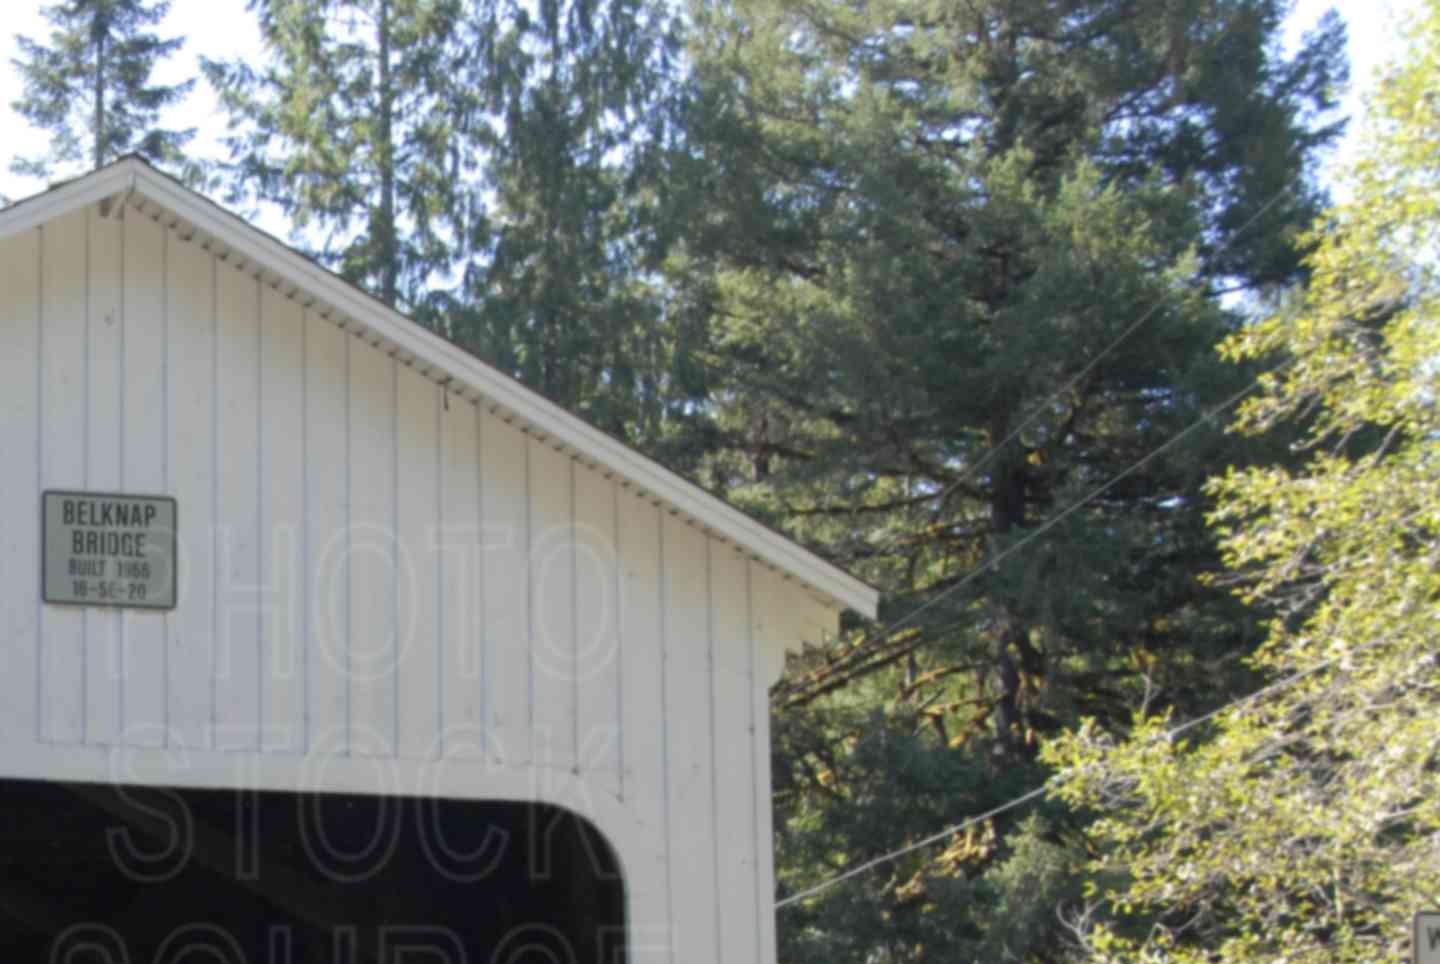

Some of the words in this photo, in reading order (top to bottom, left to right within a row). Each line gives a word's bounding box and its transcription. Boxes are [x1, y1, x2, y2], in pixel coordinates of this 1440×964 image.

[63, 500, 156, 528] BELKNAP
[72, 530, 147, 557] BRIDGE
[68, 558, 106, 577] BUILT
